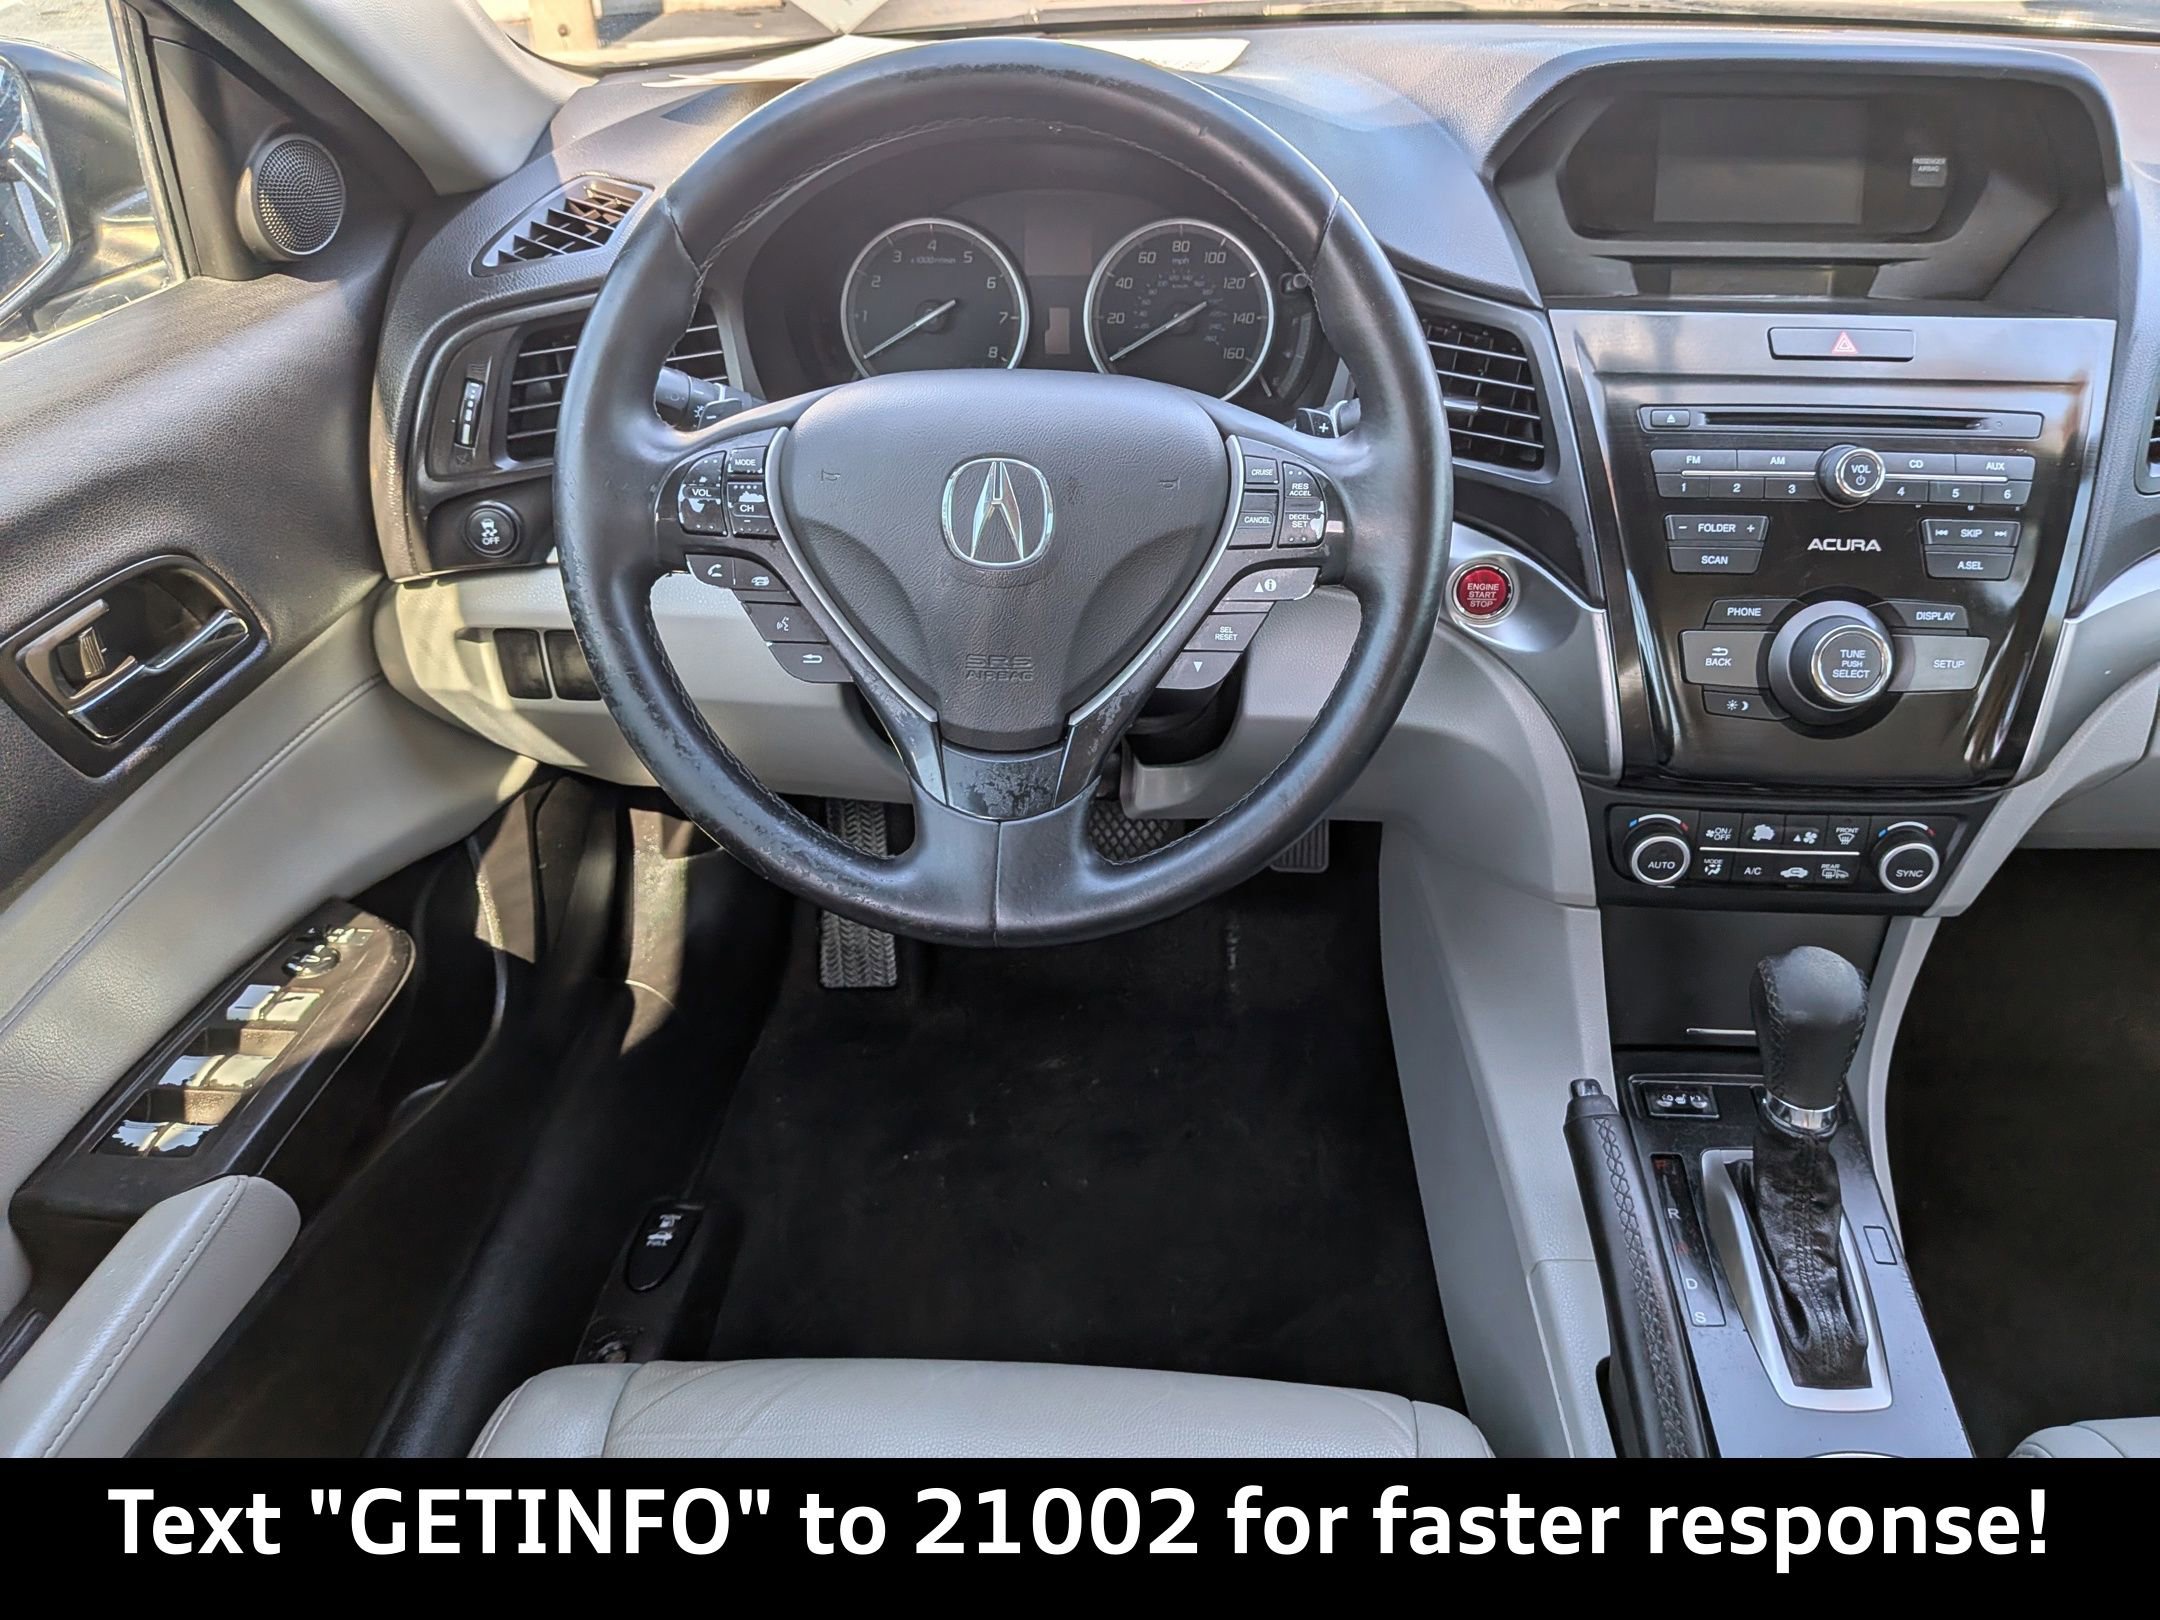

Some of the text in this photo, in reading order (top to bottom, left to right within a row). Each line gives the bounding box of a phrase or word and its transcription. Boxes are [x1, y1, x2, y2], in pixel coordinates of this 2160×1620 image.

[927, 240, 936, 251] 4
[1172, 241, 1190, 252] 80
[893, 251, 902, 263] 3
[963, 251, 973, 263] 5
[1138, 252, 1156, 264] 60
[1204, 252, 1226, 264] 100
[872, 276, 881, 288] 2
[986, 277, 996, 289] 6
[1115, 278, 1133, 289] 40
[1223, 277, 1246, 290] 120
[862, 311, 868, 323] 1
[999, 312, 1009, 324] 7
[1107, 312, 1125, 324] 20
[1232, 312, 1255, 324] 140
[988, 347, 998, 358] 8
[1223, 348, 1245, 360] 160
[735, 458, 756, 466] MODE
[1686, 456, 1701, 465] FM
[1770, 456, 1786, 466] AM
[1909, 460, 1923, 468] CD
[1252, 468, 1272, 476] CRUISE
[1851, 464, 1871, 474] VOL
[1986, 462, 2005, 472] AUX
[692, 488, 712, 497] VOL
[1680, 482, 1686, 492] 1
[1732, 484, 1740, 493] 2
[1788, 484, 1796, 494] 3
[1897, 486, 1905, 496] 4
[1952, 488, 1960, 498] 5
[2004, 489, 2012, 500] 6
[740, 504, 754, 513] CH
[1244, 516, 1271, 524] CANCEL
[1292, 520, 1308, 528] SET
[1698, 522, 1736, 534] FOLDER
[1960, 528, 1984, 538] SKIP
[482, 537, 500, 545] OFF
[1807, 538, 1882, 552] ACURA
[1701, 554, 1728, 566] SCAN
[1468, 590, 1496, 598] START
[1727, 607, 1762, 618] PHONE
[1916, 611, 1956, 622] DISPLAY
[1220, 626, 1234, 634] SEL
[1840, 650, 1866, 659] TUNE
[965, 654, 1032, 670] SRS
[1705, 657, 1732, 668] BACK
[1841, 660, 1864, 668] PUSH
[1933, 660, 1965, 670] SETUP
[965, 670, 1033, 682] AIRBAG
[1832, 669, 1870, 680] SELECT
[1714, 833, 1731, 841] OFF
[1648, 860, 1676, 870] AUTO
[1744, 866, 1762, 876] A/C
[1896, 869, 1924, 878] SYNC
[1668, 1208, 1680, 1220] R
[1685, 1278, 1698, 1290] D
[1694, 1312, 1706, 1324] S
